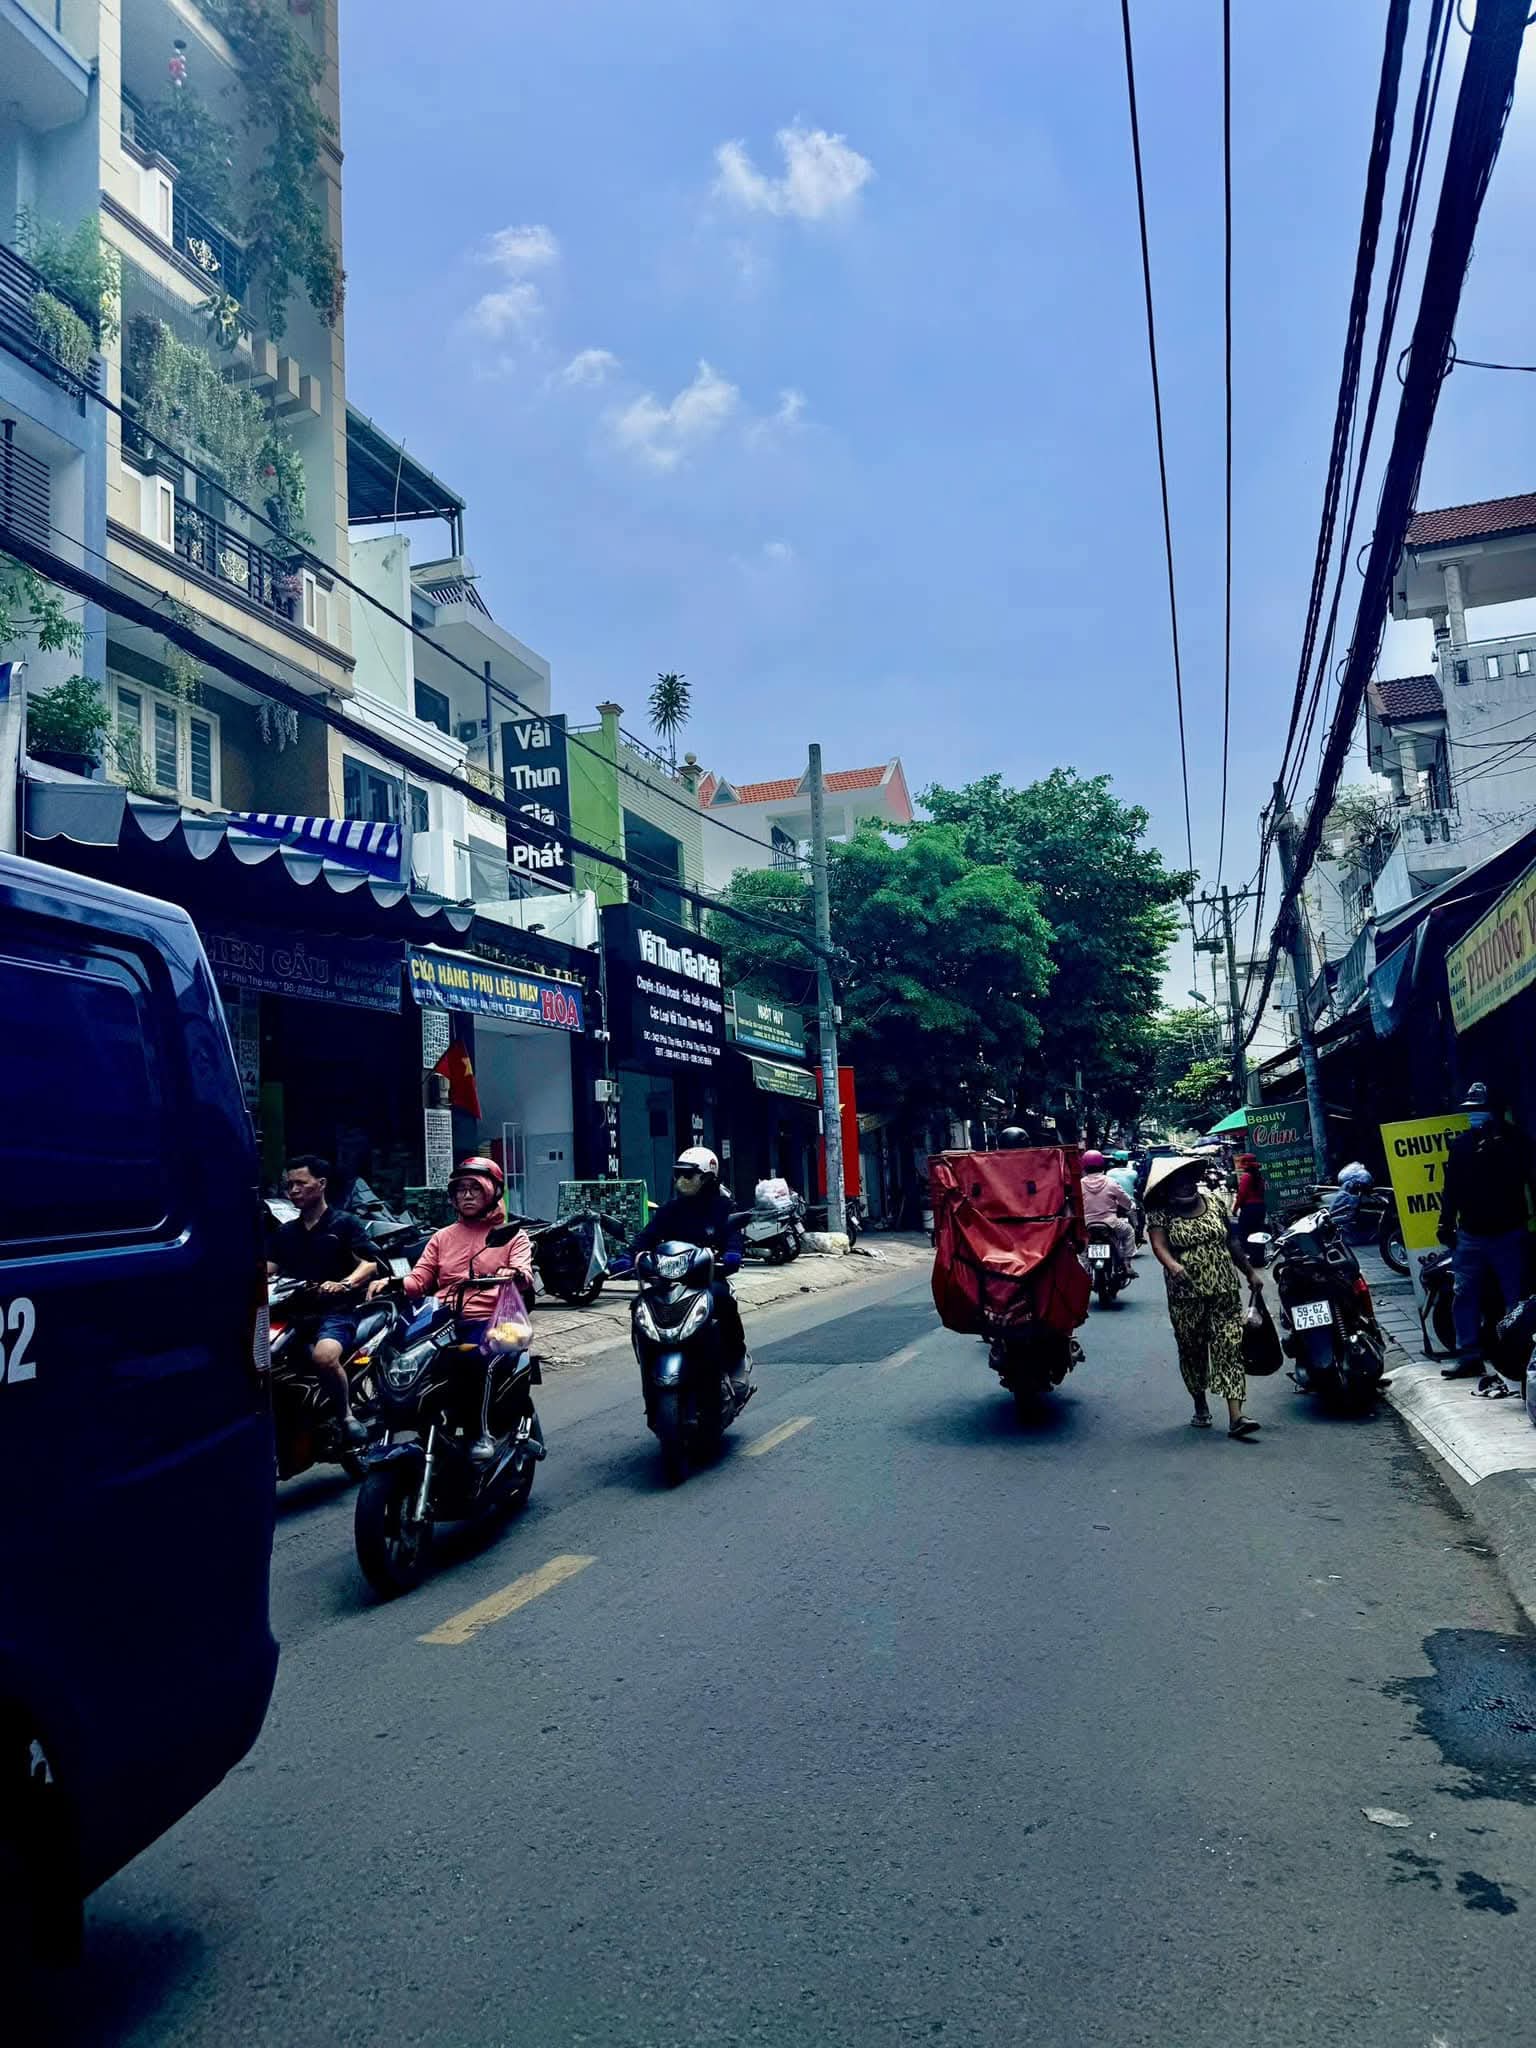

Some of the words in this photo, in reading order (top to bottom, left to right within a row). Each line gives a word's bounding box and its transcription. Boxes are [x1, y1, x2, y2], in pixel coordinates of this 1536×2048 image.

[513, 722, 551, 750] Vải
[510, 765, 561, 790] Thun
[513, 841, 564, 869] Phát
[637, 929, 656, 965] Vải
[652, 935, 682, 974] Thun
[680, 948, 698, 979] Gia
[697, 953, 721, 988] Phát
[411, 954, 435, 982] CỬA
[438, 963, 469, 989] HÀNG
[472, 971, 494, 998] PHỤ
[495, 975, 517, 1001] LIỆU
[519, 981, 539, 1003] MAY
[540, 984, 580, 1027] HÒA
[1247, 1111, 1287, 1125] Beauty
[1424, 1164, 1435, 1182] 7
